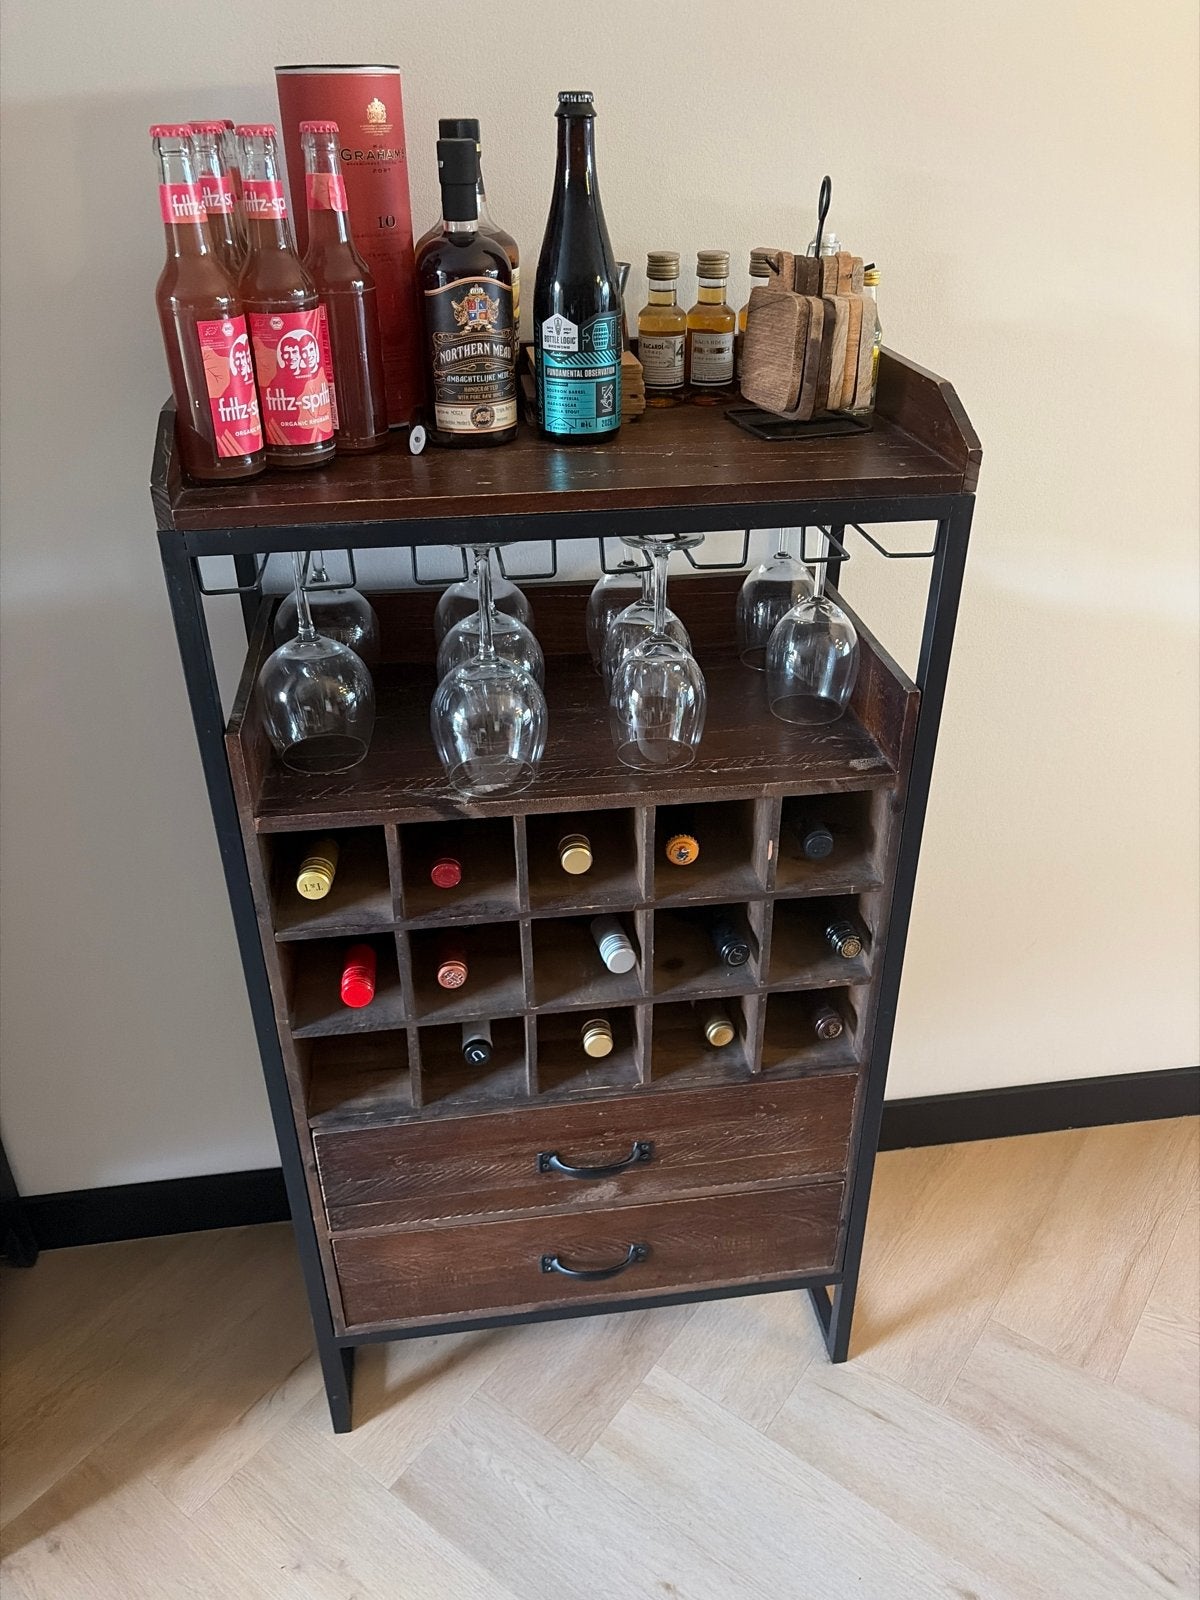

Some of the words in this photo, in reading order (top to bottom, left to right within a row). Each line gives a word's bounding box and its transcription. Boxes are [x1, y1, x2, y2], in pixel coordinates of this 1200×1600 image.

[377, 215, 396, 229] 10
[544, 334, 560, 344] BOTTLE
[560, 336, 576, 345] LOGIC
[440, 342, 490, 365] NORTHERN
[675, 343, 684, 359] 4
[446, 374, 496, 383] AMBACHTELIJKE
[546, 367, 583, 378] FUNDAMENTAL
[584, 366, 615, 378] OBSERVATION
